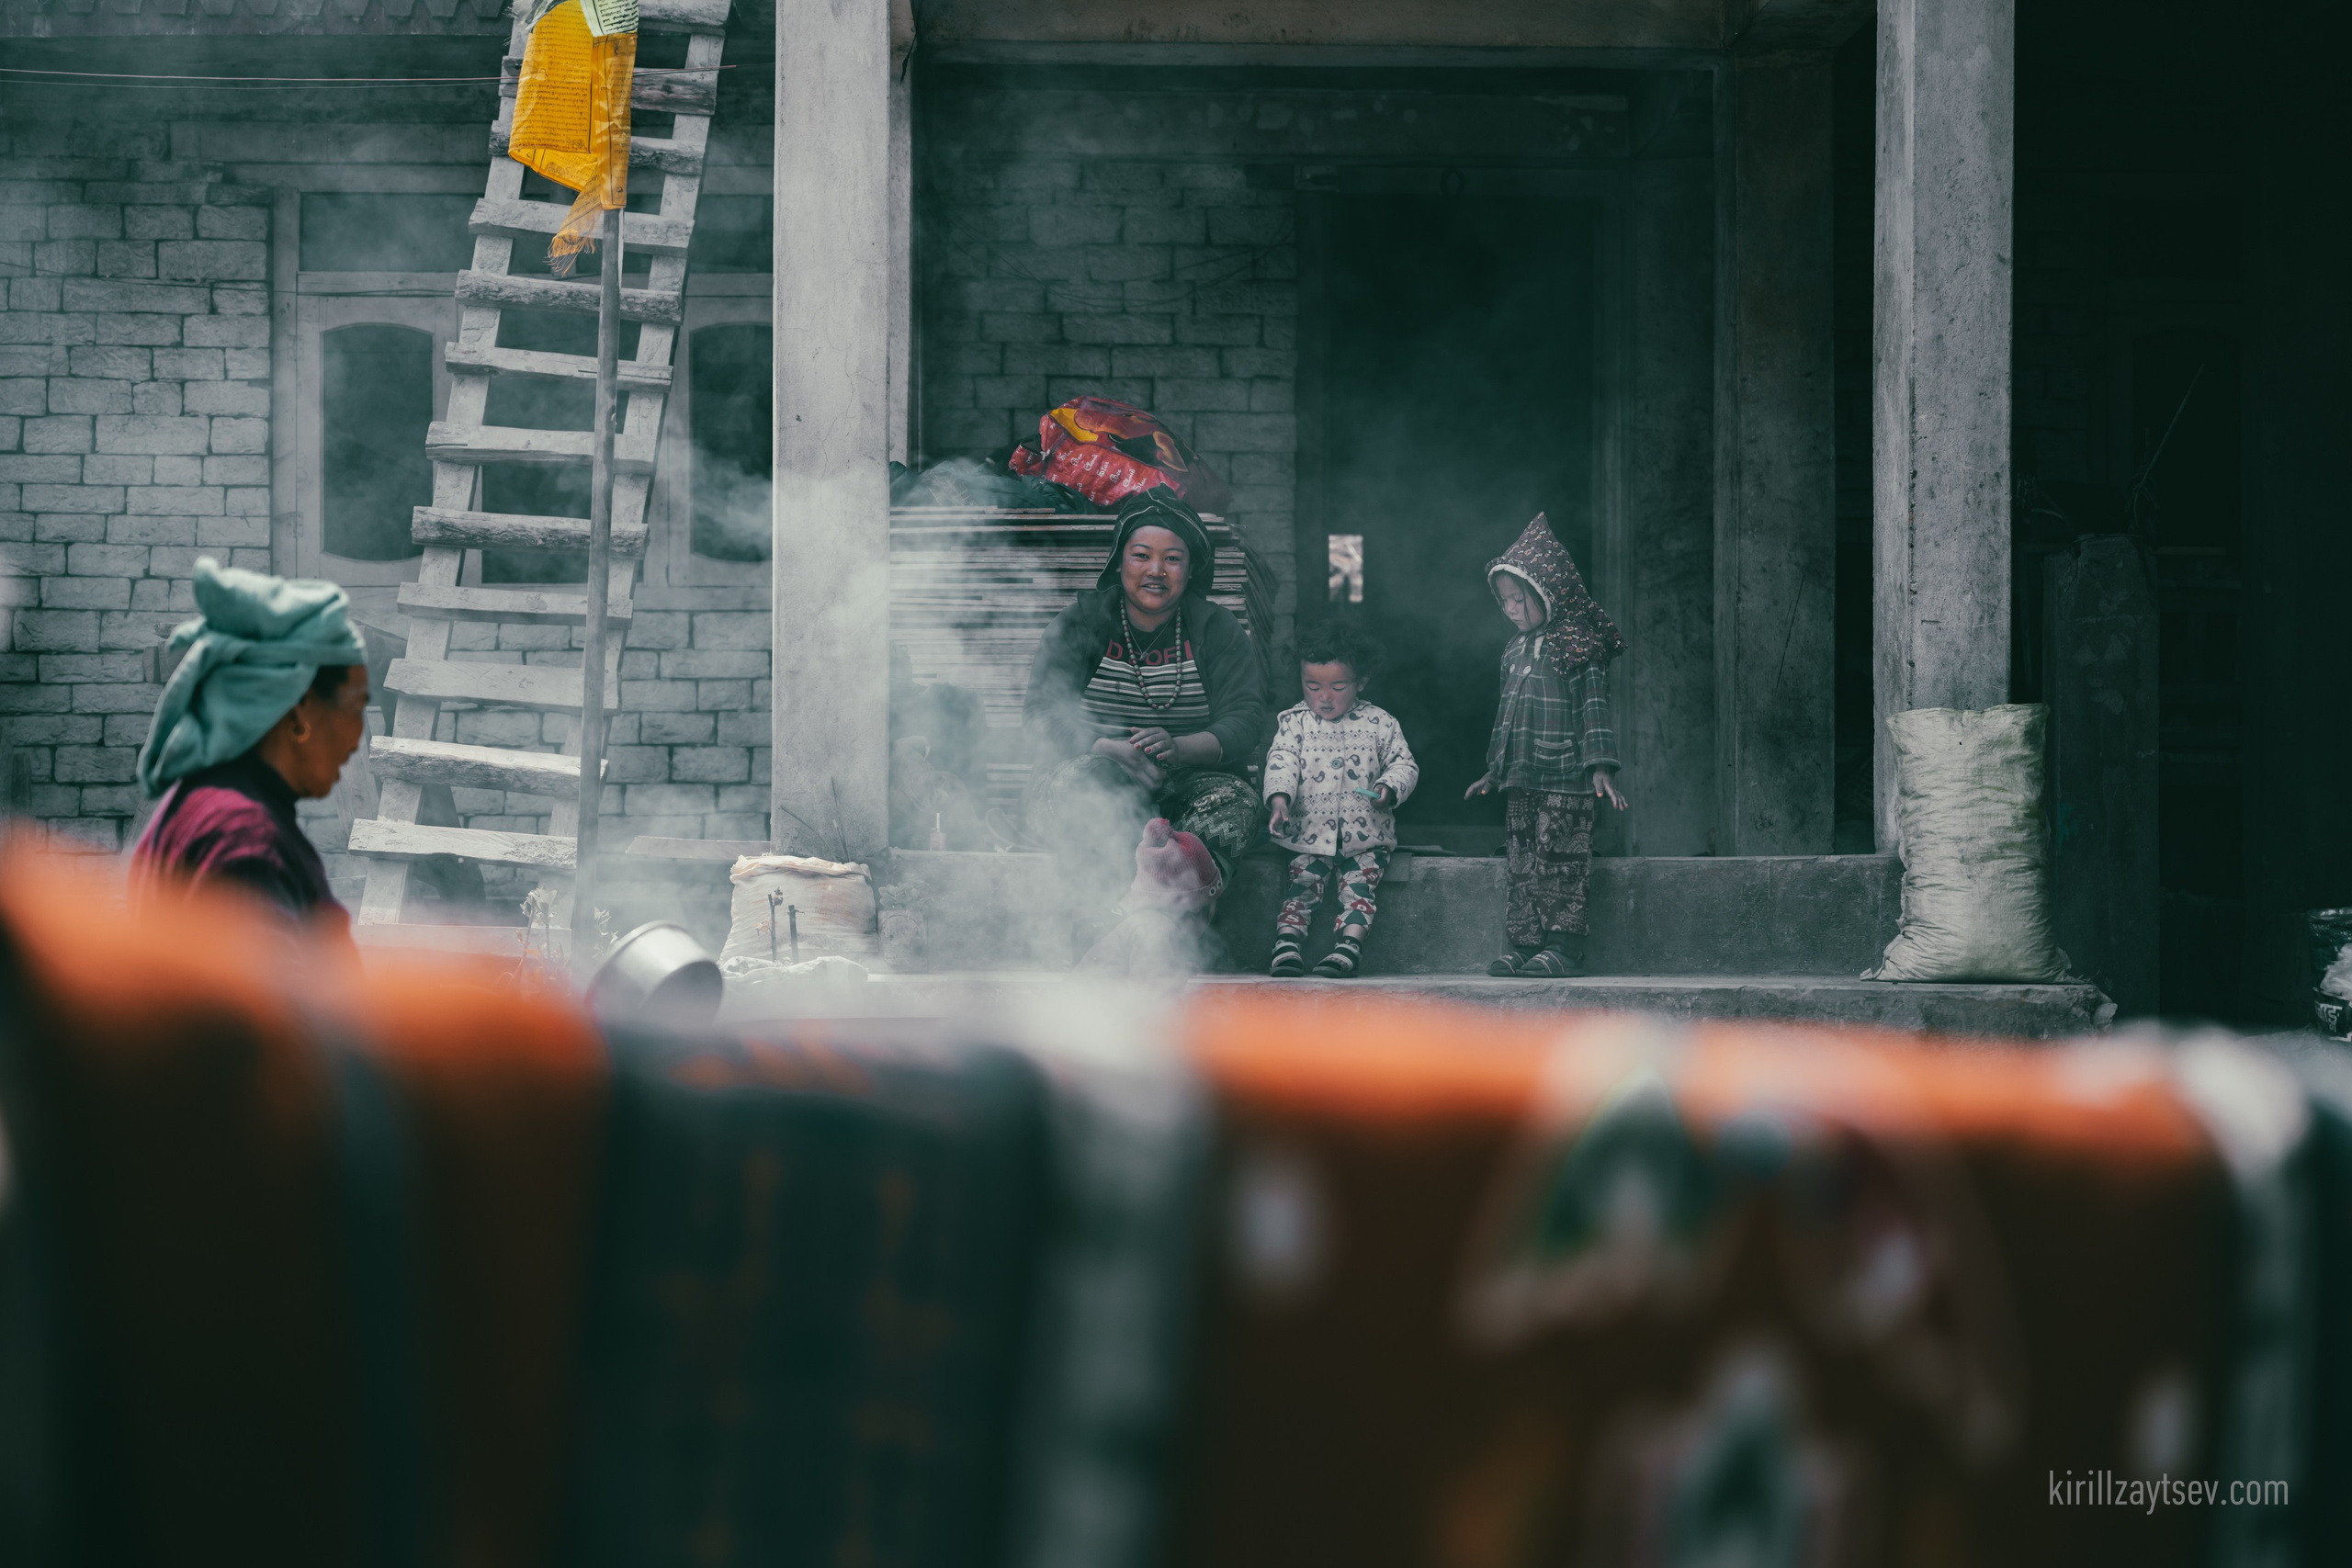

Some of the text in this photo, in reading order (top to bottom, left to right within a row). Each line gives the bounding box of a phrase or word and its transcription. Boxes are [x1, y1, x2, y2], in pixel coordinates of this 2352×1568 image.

[1083, 454, 1098, 471] Cloud
[1096, 461, 1109, 478] Star
[1122, 468, 1136, 488] Cloud
[1132, 478, 1147, 493] Star
